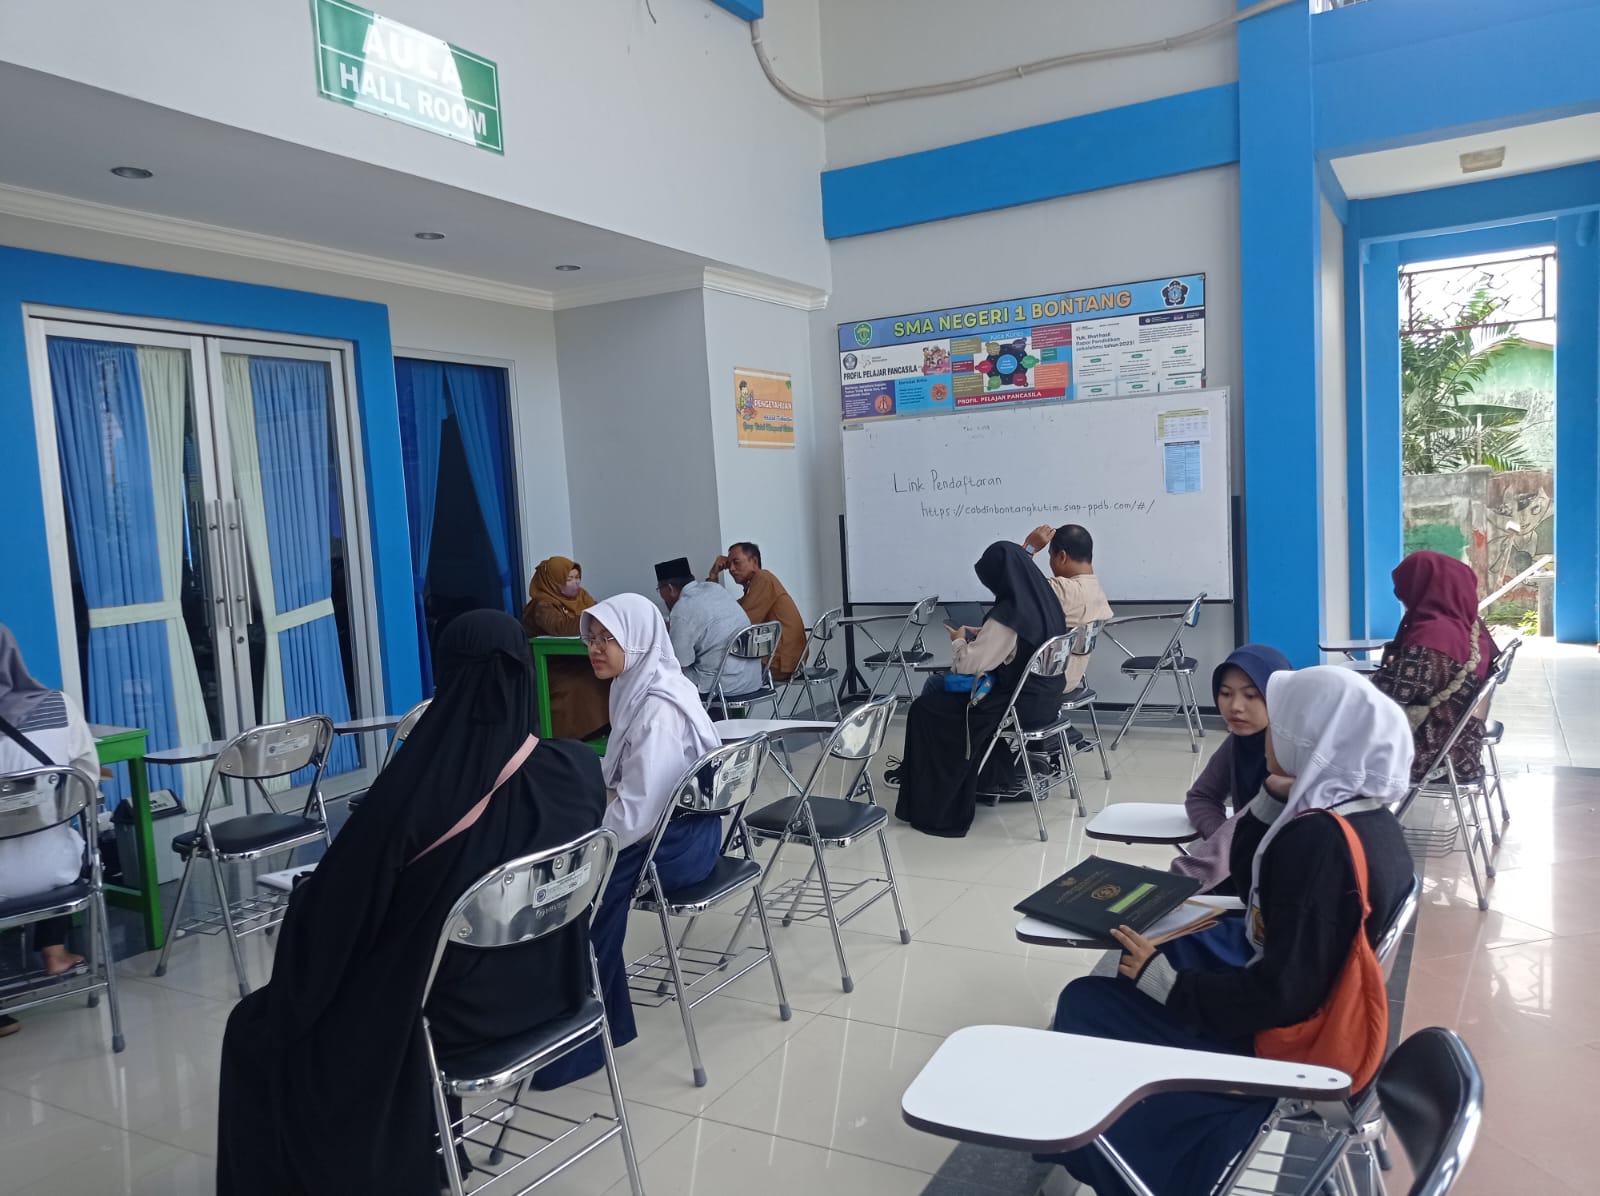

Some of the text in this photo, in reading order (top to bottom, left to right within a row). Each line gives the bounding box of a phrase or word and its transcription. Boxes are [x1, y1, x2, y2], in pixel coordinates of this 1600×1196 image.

[362, 23, 463, 91] AULA
[339, 62, 487, 136] HALL ROOM
[894, 290, 1132, 337] SMA NEGERI 1 BONTANG
[843, 364, 918, 380] PROFIL PELAJAR PANCASILA
[1007, 391, 1042, 400] PANCASILA
[893, 469, 1002, 495] Link Pendaftaran
